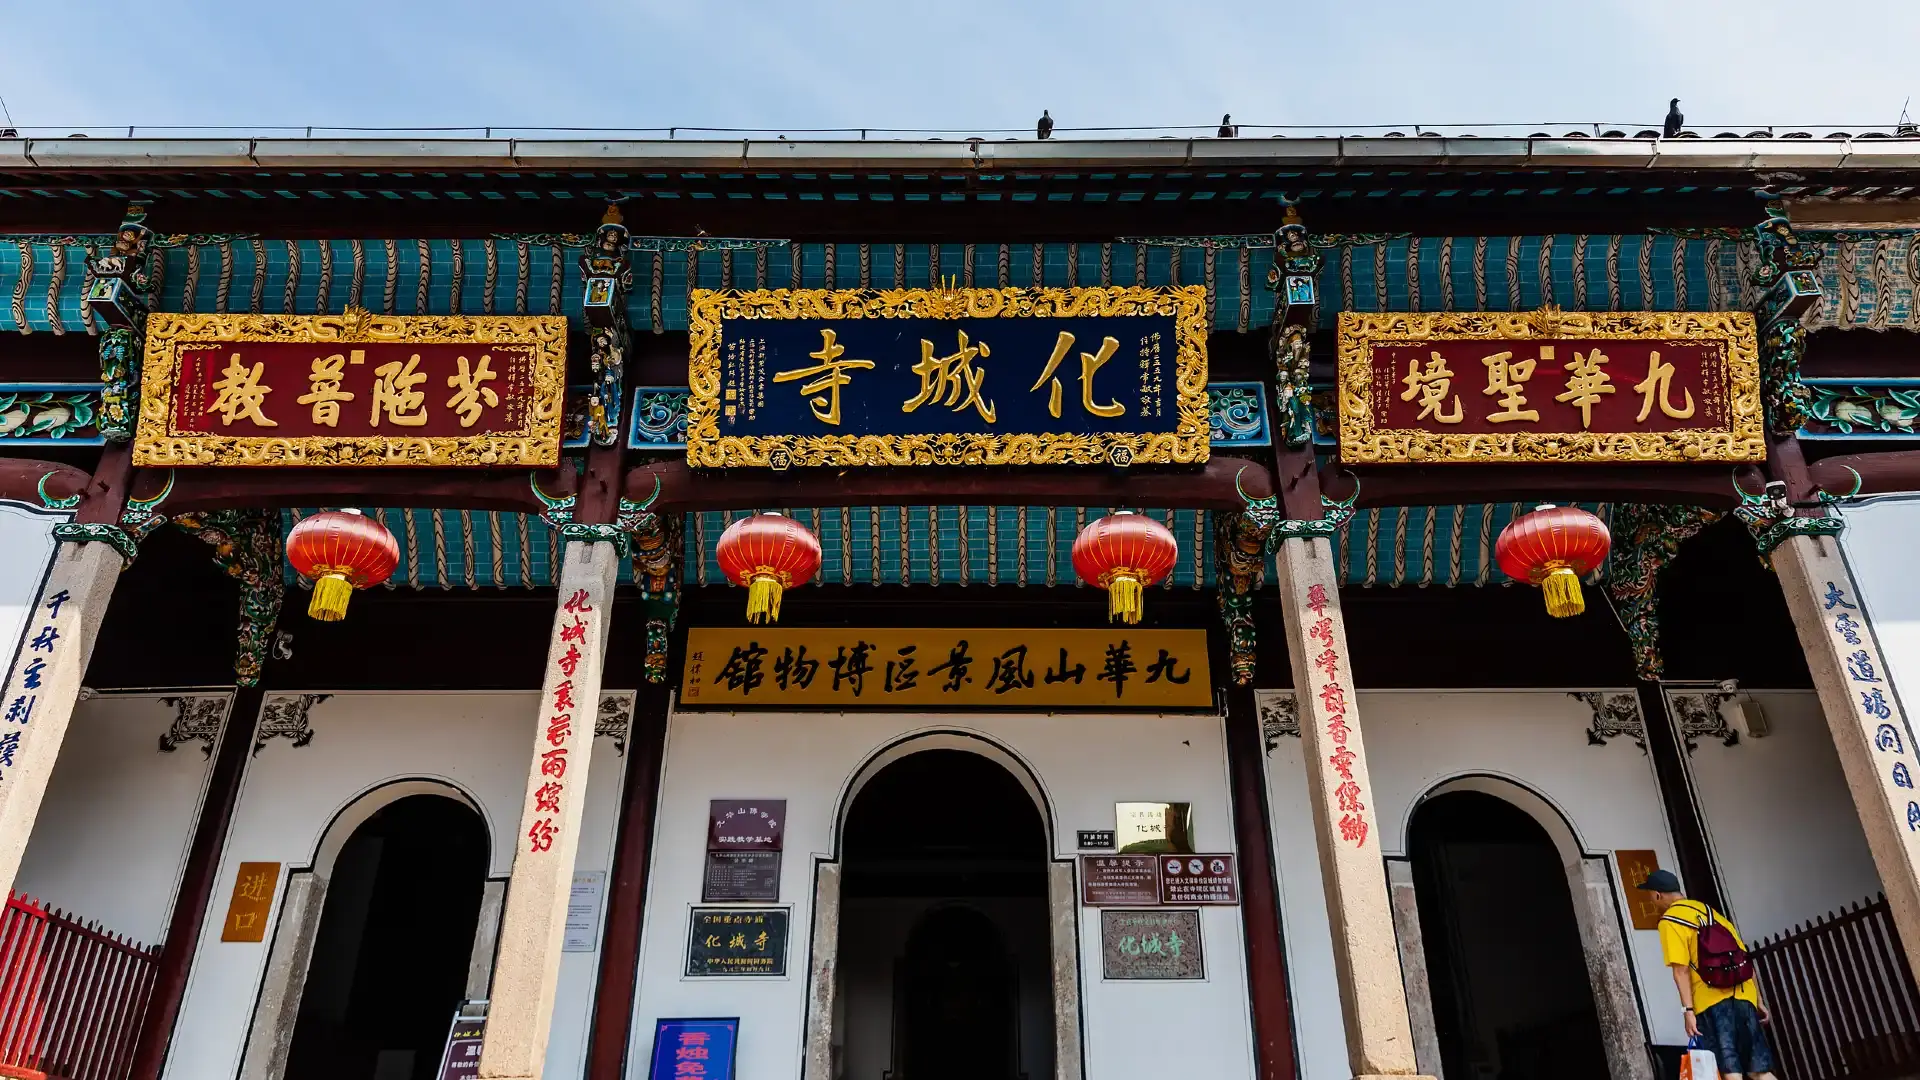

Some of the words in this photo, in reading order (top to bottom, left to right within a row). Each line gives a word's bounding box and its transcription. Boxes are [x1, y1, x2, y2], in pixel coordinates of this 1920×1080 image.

[773, 328, 1127, 426] 化城寺
[1400, 348, 1695, 429] 九華聖境
[714, 641, 1191, 698] 九華山風景區博物館
[239, 872, 268, 931] 进口
[705, 931, 769, 951] 化城寺
[1119, 930, 1185, 957] 化城寺
